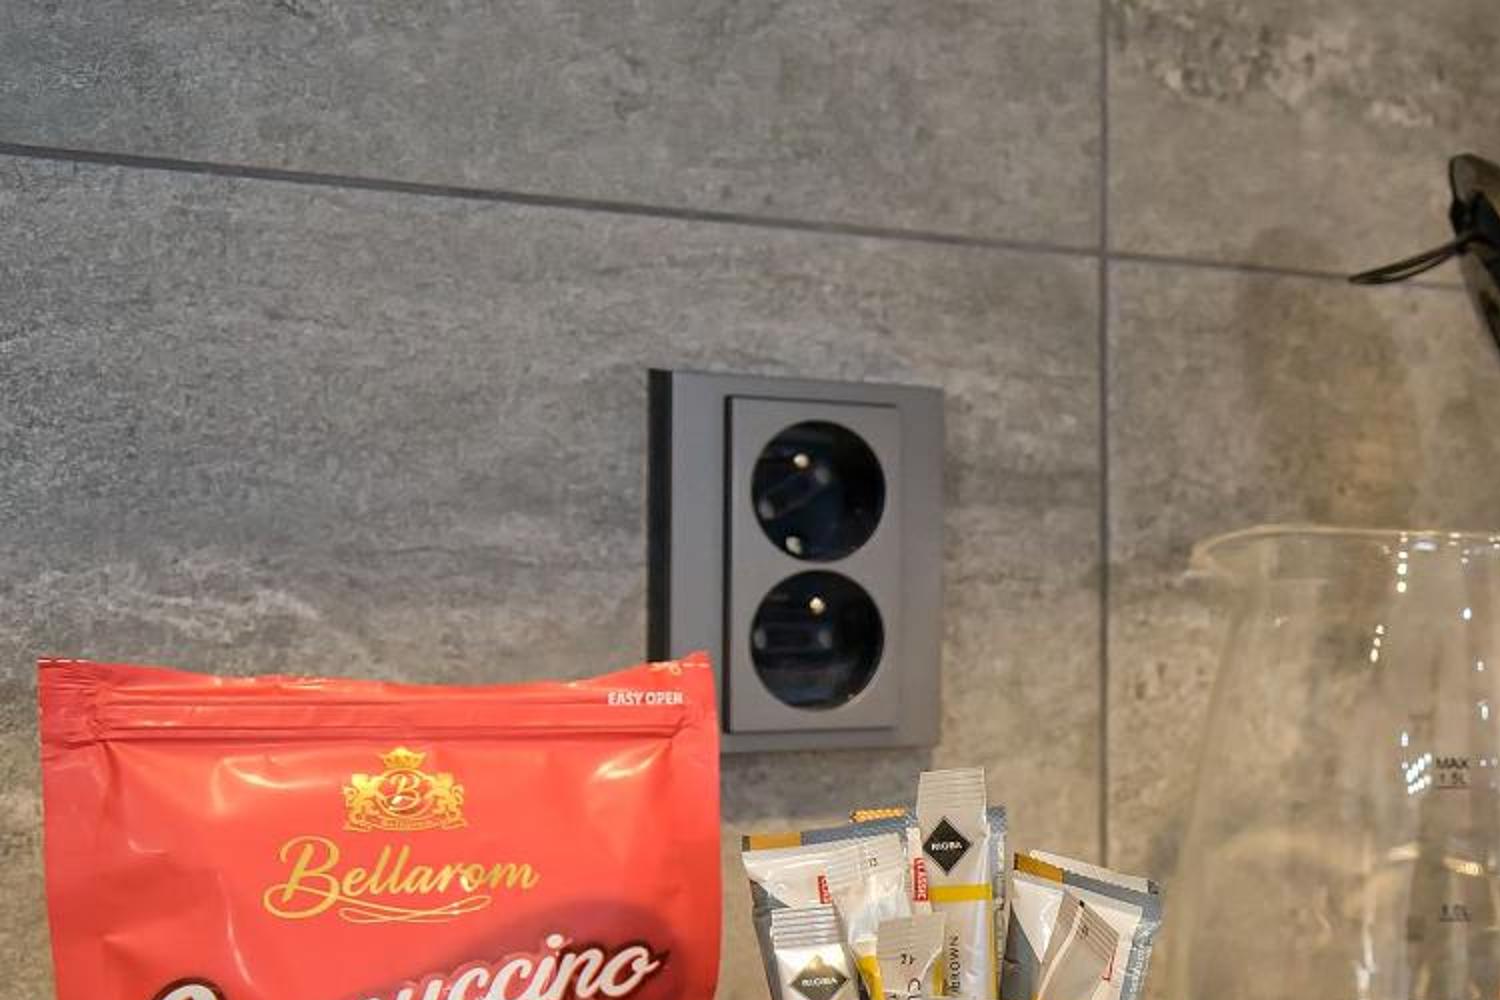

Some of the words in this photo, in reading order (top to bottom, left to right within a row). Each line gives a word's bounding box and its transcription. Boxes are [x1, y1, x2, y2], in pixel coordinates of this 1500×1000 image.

[607, 691, 643, 705] EASY
[645, 691, 684, 705] OPEN
[1436, 757, 1469, 770] MAX
[263, 836, 539, 921] Bellarom
